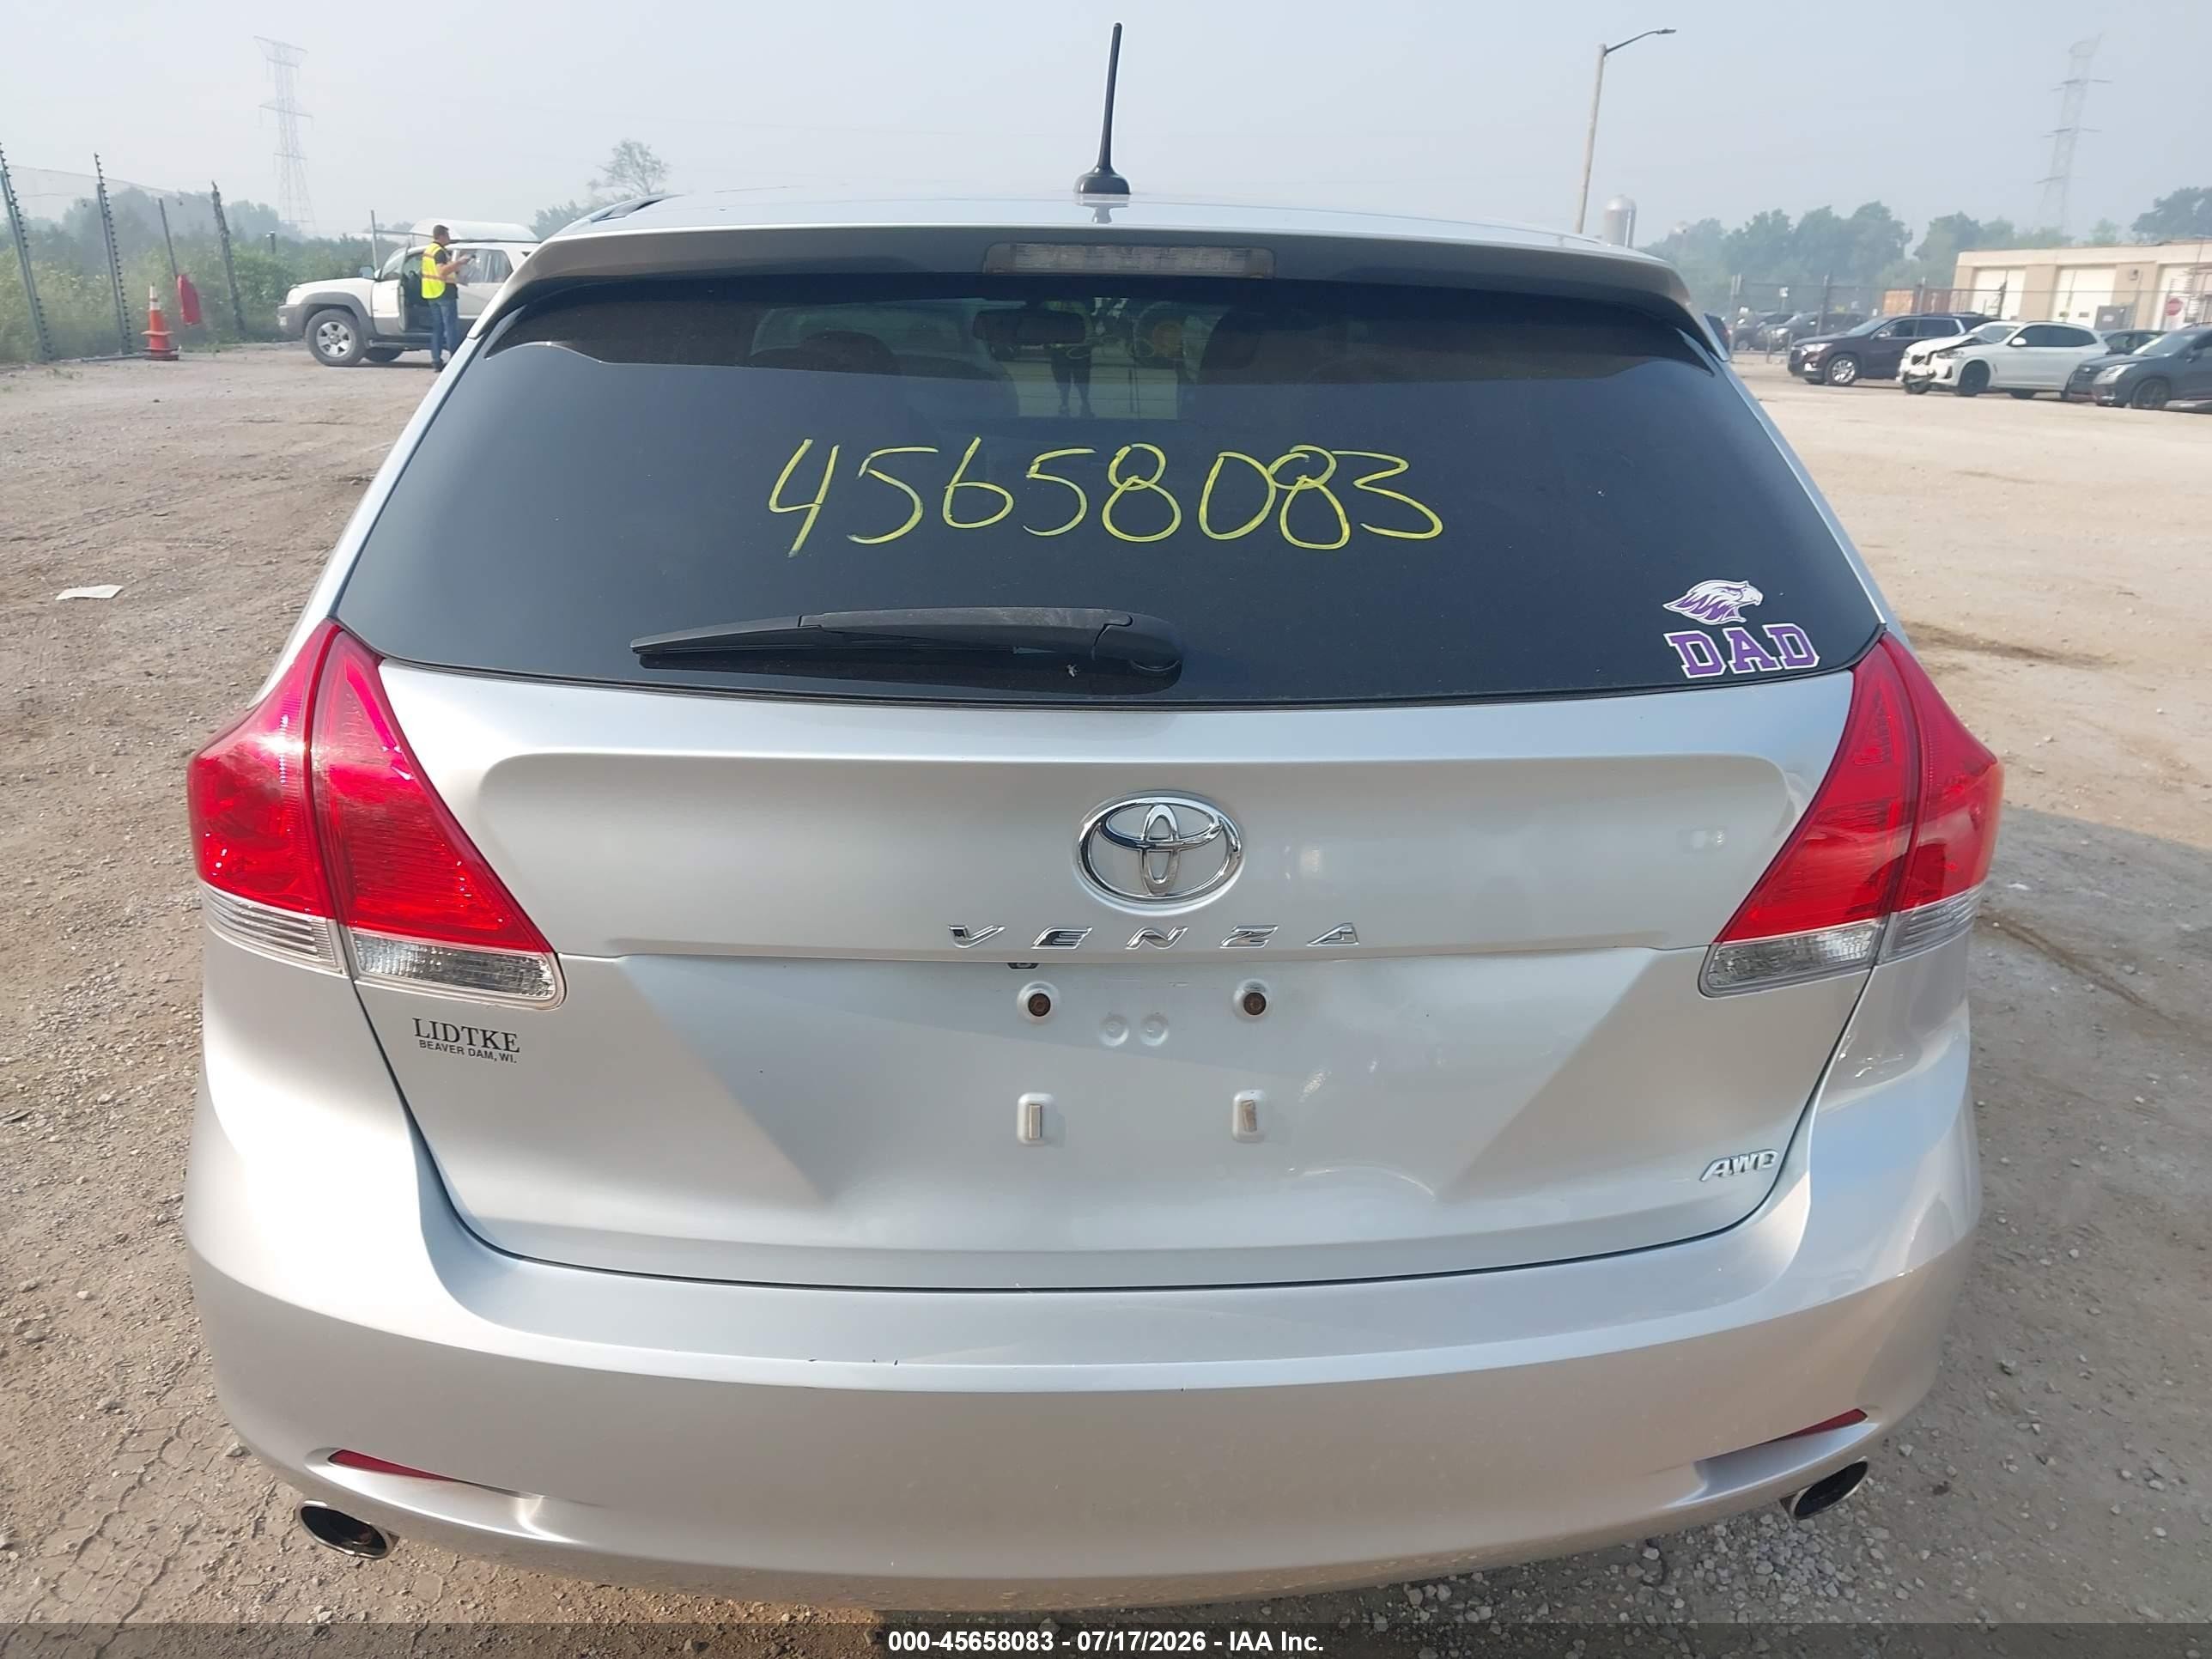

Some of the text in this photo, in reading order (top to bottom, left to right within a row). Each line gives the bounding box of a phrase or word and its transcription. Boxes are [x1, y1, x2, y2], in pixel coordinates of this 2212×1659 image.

[768, 435, 1443, 558] 45658083
[1662, 623, 1820, 678] DAD
[947, 922, 1360, 950] VENZA
[412, 1018, 520, 1053] LIDTKE
[418, 1039, 465, 1055] BEAVER
[467, 1048, 498, 1062] DAM,
[1699, 1149, 1779, 1182] AWD
